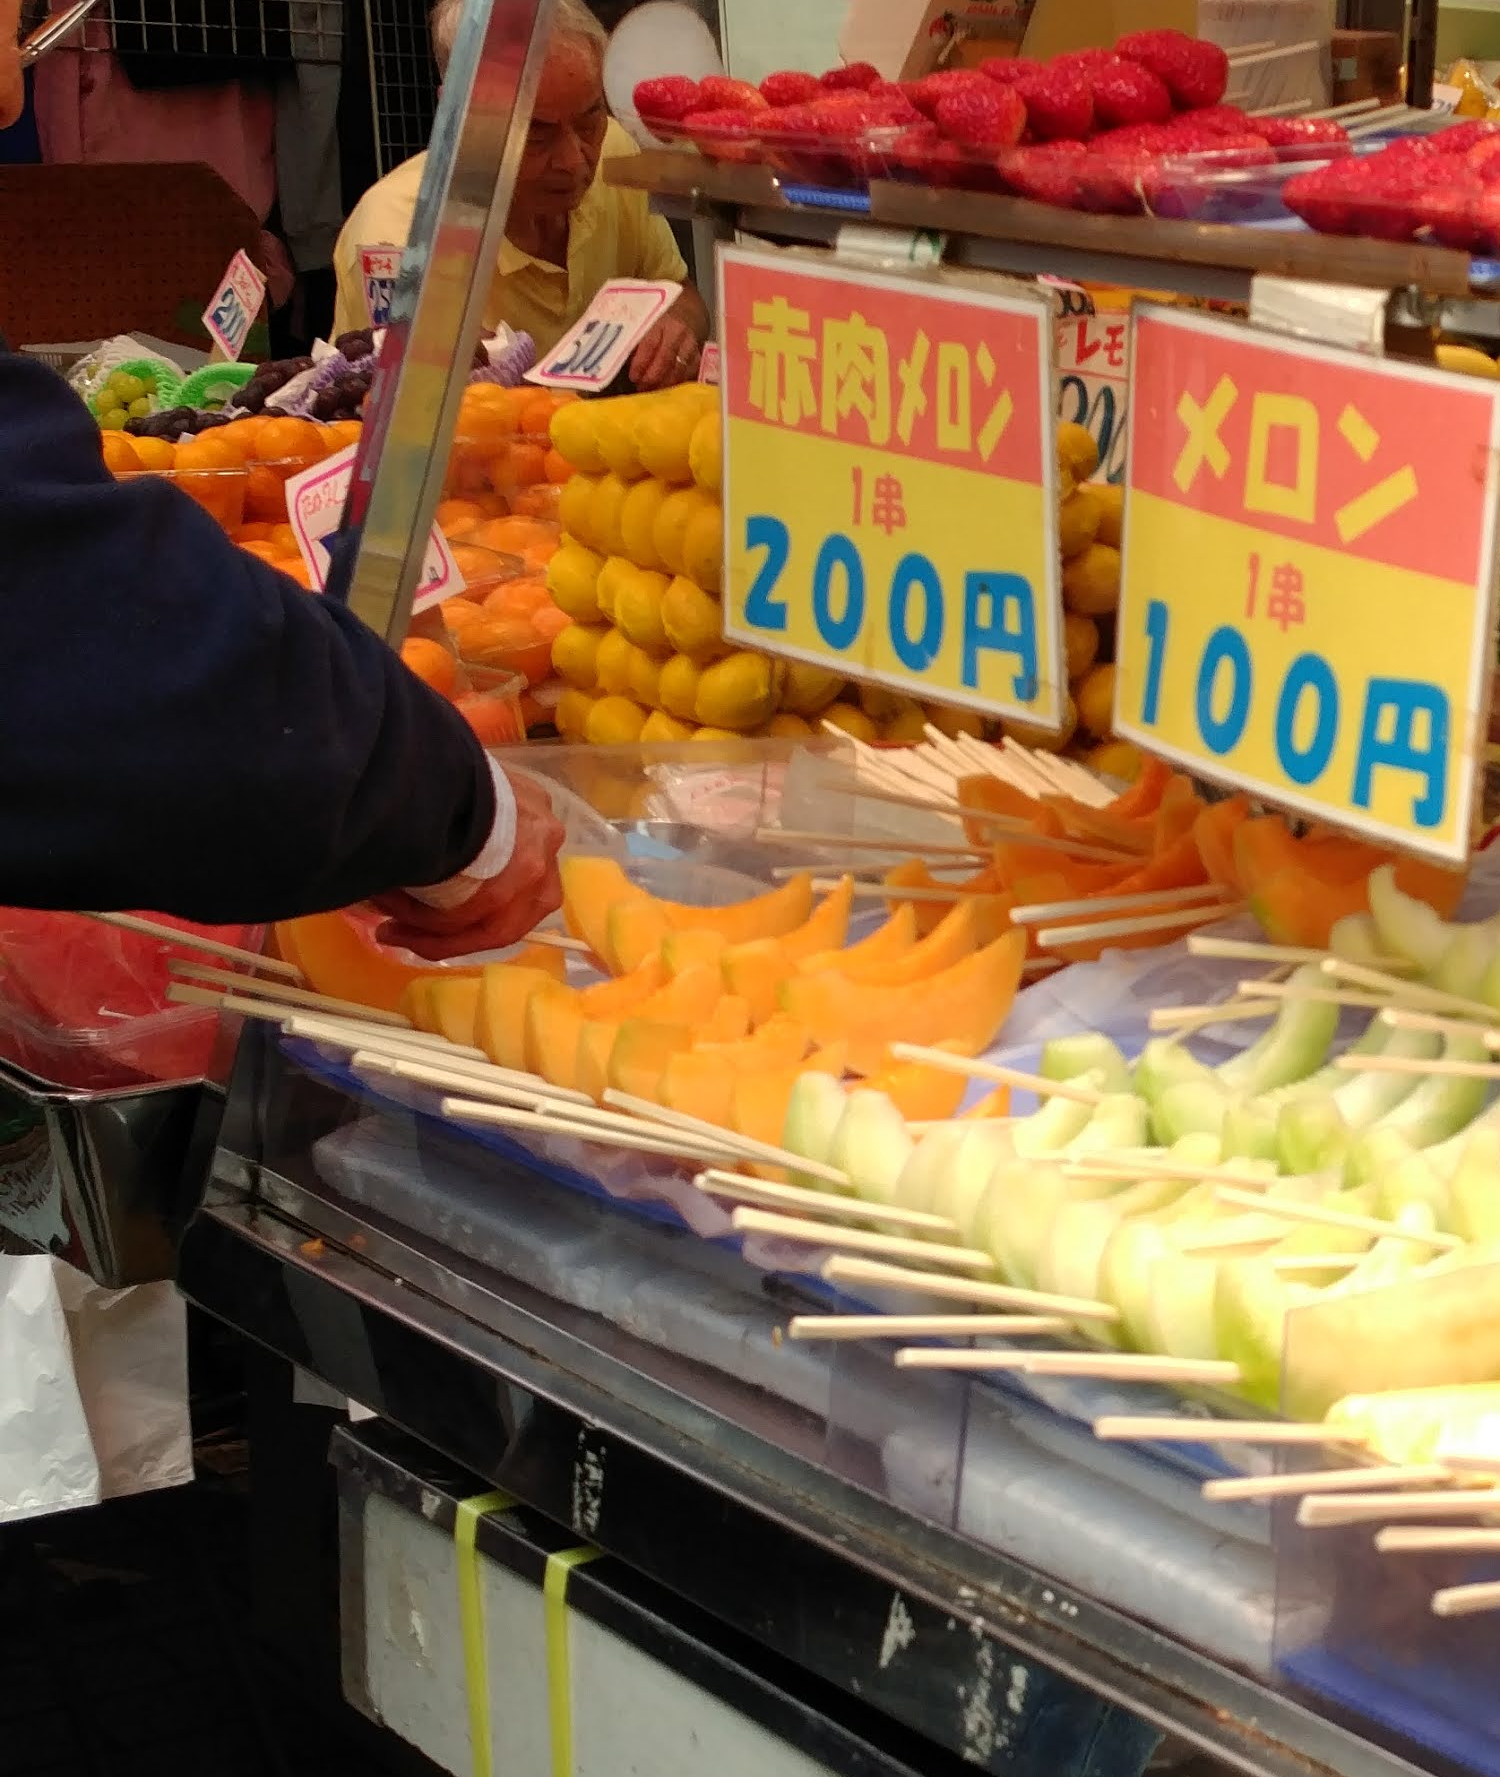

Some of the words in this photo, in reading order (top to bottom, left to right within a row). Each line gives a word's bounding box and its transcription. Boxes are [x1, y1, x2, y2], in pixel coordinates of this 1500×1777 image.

[747, 295, 1015, 463] 赤肉メロン
[1172, 375, 1418, 544] メロン
[851, 467, 908, 535] 1串
[745, 515, 1039, 702] 200円
[1246, 553, 1307, 630] 1串
[1143, 600, 1451, 829] 100円
